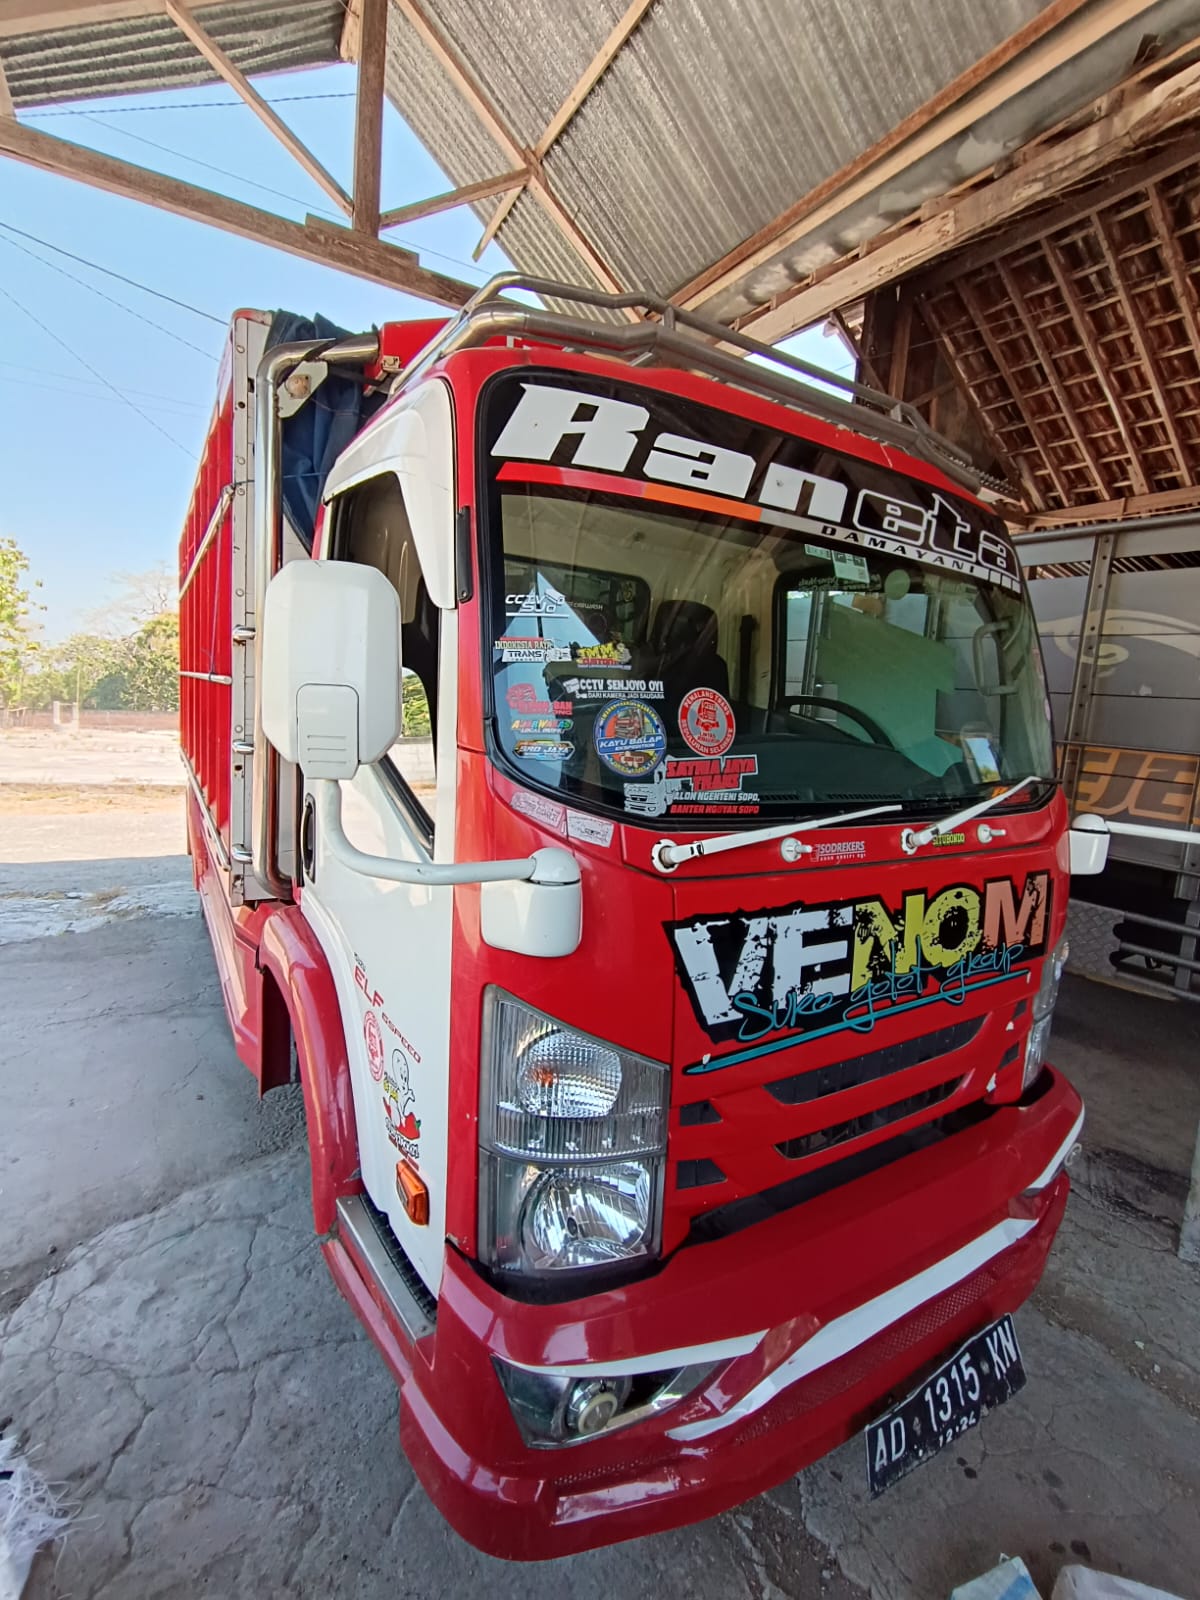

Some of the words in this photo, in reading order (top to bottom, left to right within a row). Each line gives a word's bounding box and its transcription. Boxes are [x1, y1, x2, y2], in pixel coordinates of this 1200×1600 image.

[507, 650, 542, 658] TRANS
[580, 679, 604, 690] CCTV
[649, 681, 664, 692] OYI
[600, 739, 628, 748] KAYU
[629, 736, 662, 745] BALAP
[670, 804, 704, 814] BANTER
[740, 805, 760, 814] SOPO
[675, 873, 1049, 1025] VENOM
[354, 965, 385, 1007] ELF
[875, 1417, 906, 1473] AD
[925, 1352, 980, 1432] 1315
[985, 1320, 1018, 1381] KN
